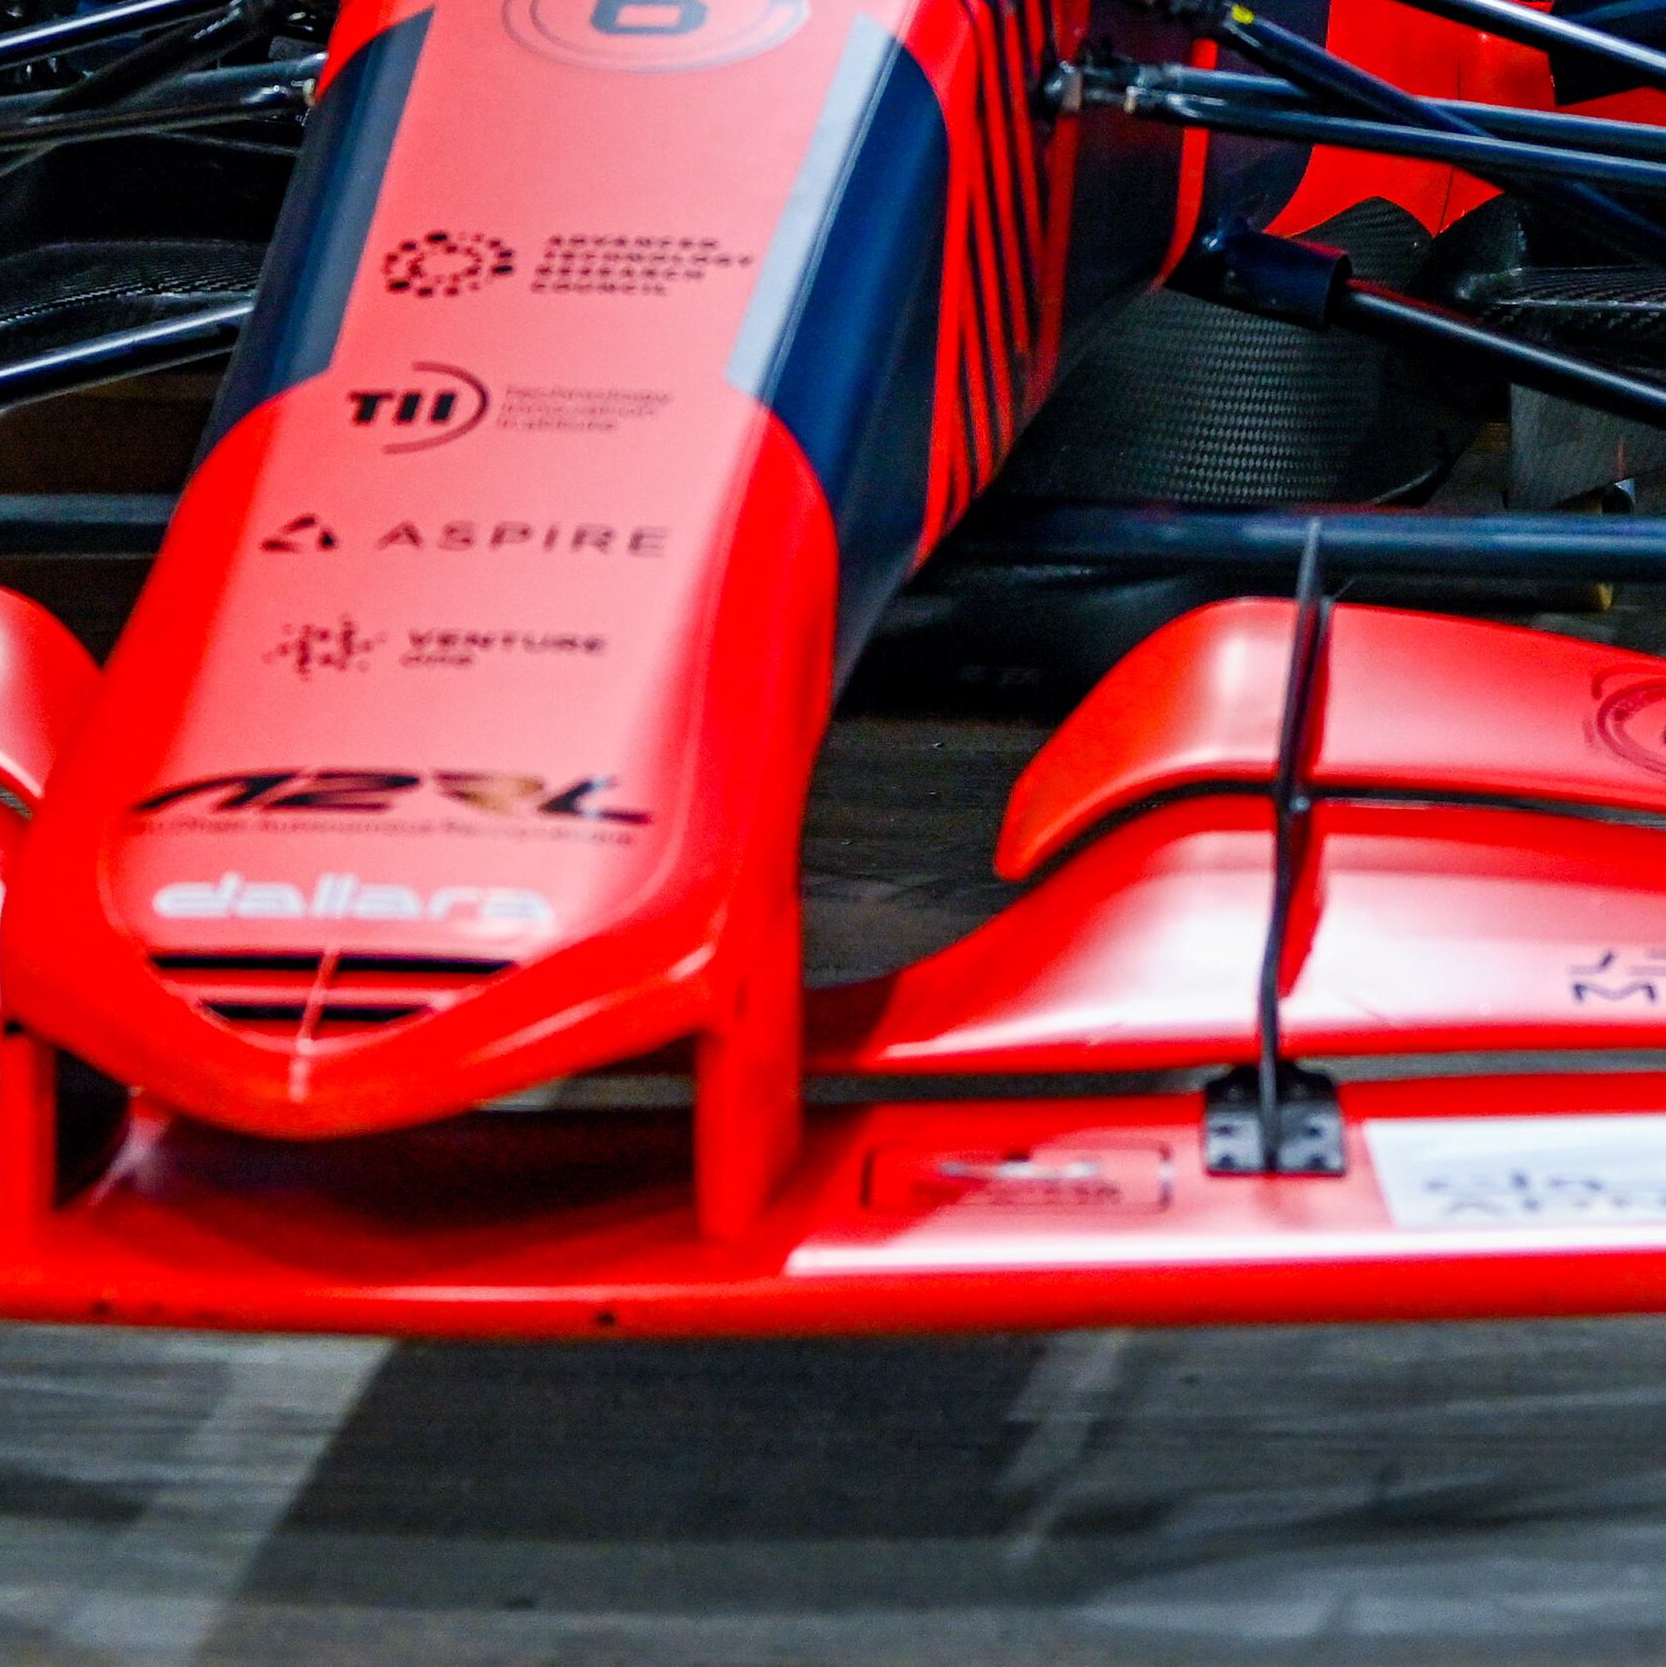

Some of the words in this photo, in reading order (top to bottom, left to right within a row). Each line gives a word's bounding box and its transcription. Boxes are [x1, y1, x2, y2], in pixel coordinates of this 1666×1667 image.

[348, 390, 457, 425] TII
[376, 523, 669, 558] ASPIRE
[408, 630, 608, 655] VENTURE
[123, 766, 654, 825] A2RL
[152, 871, 559, 926] dallara
